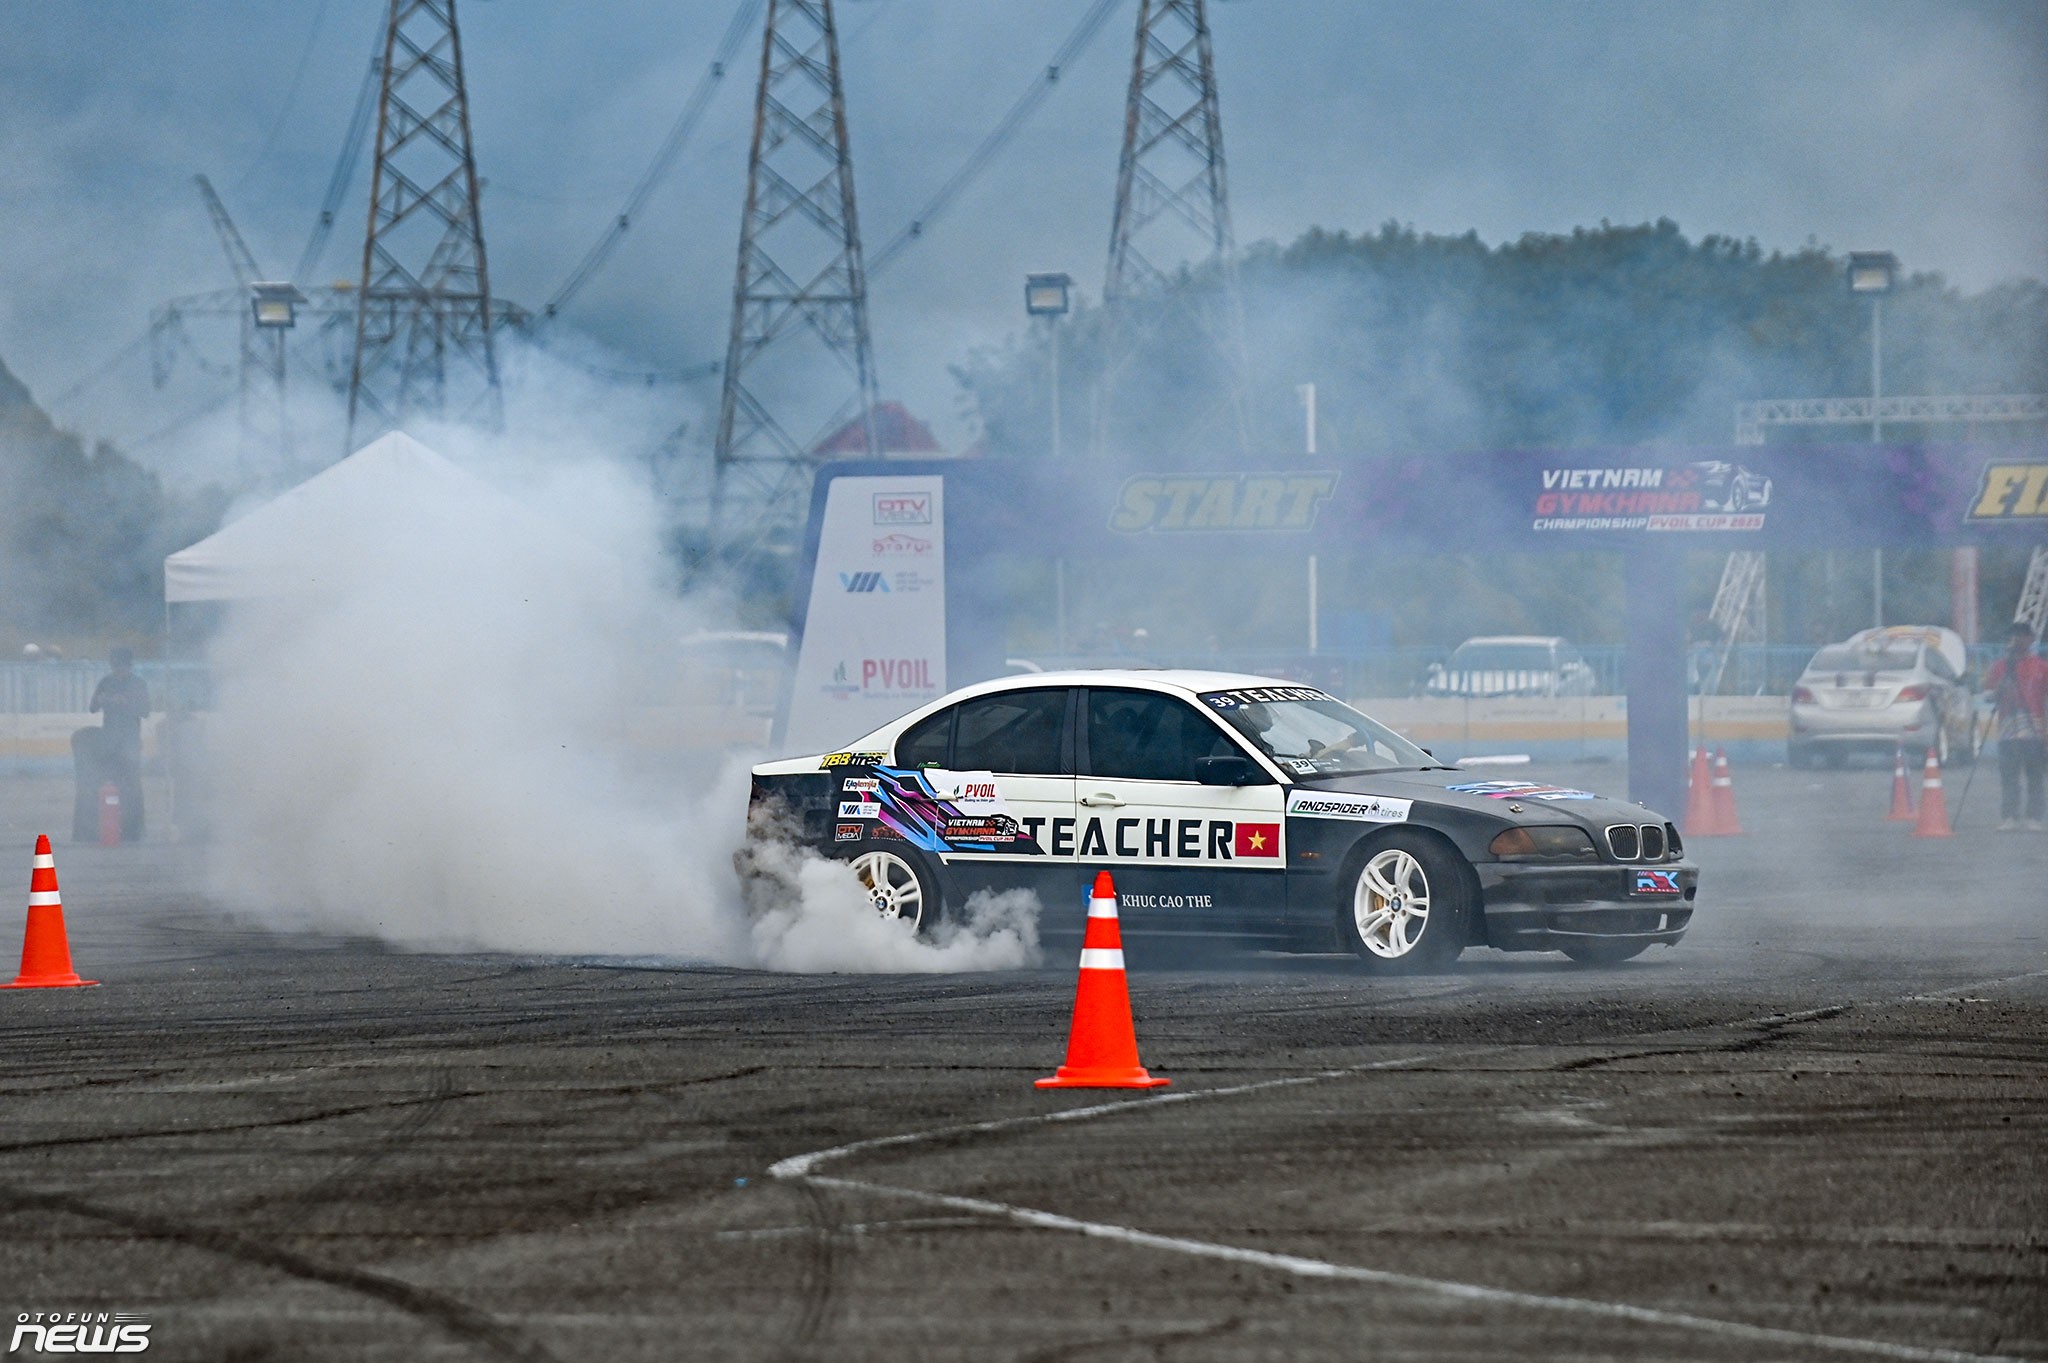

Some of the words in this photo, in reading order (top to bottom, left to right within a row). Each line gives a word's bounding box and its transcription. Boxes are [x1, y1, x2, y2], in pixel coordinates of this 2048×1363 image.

[1542, 469, 1663, 488] VIETNAM
[1115, 477, 1334, 530] START
[1536, 492, 1700, 513] GYMKHANA
[1532, 517, 1647, 530] CHAMPIONSHIP
[1650, 516, 1694, 528] PVOIL
[1699, 516, 1727, 527] CUP
[862, 658, 935, 689] PVOIL
[1209, 696, 1236, 708] 39
[1292, 760, 1310, 769] 39
[964, 783, 996, 798] PVOIL
[1290, 799, 1369, 815] LANDSPIDER
[1381, 807, 1404, 818] tires
[948, 818, 985, 827] VIETNAM
[945, 827, 996, 836] GYMKHANA
[1021, 816, 1234, 860] TEACHER
[1121, 894, 1157, 908] KHUC
[1159, 894, 1184, 908] CAO
[1186, 895, 1213, 909] THE
